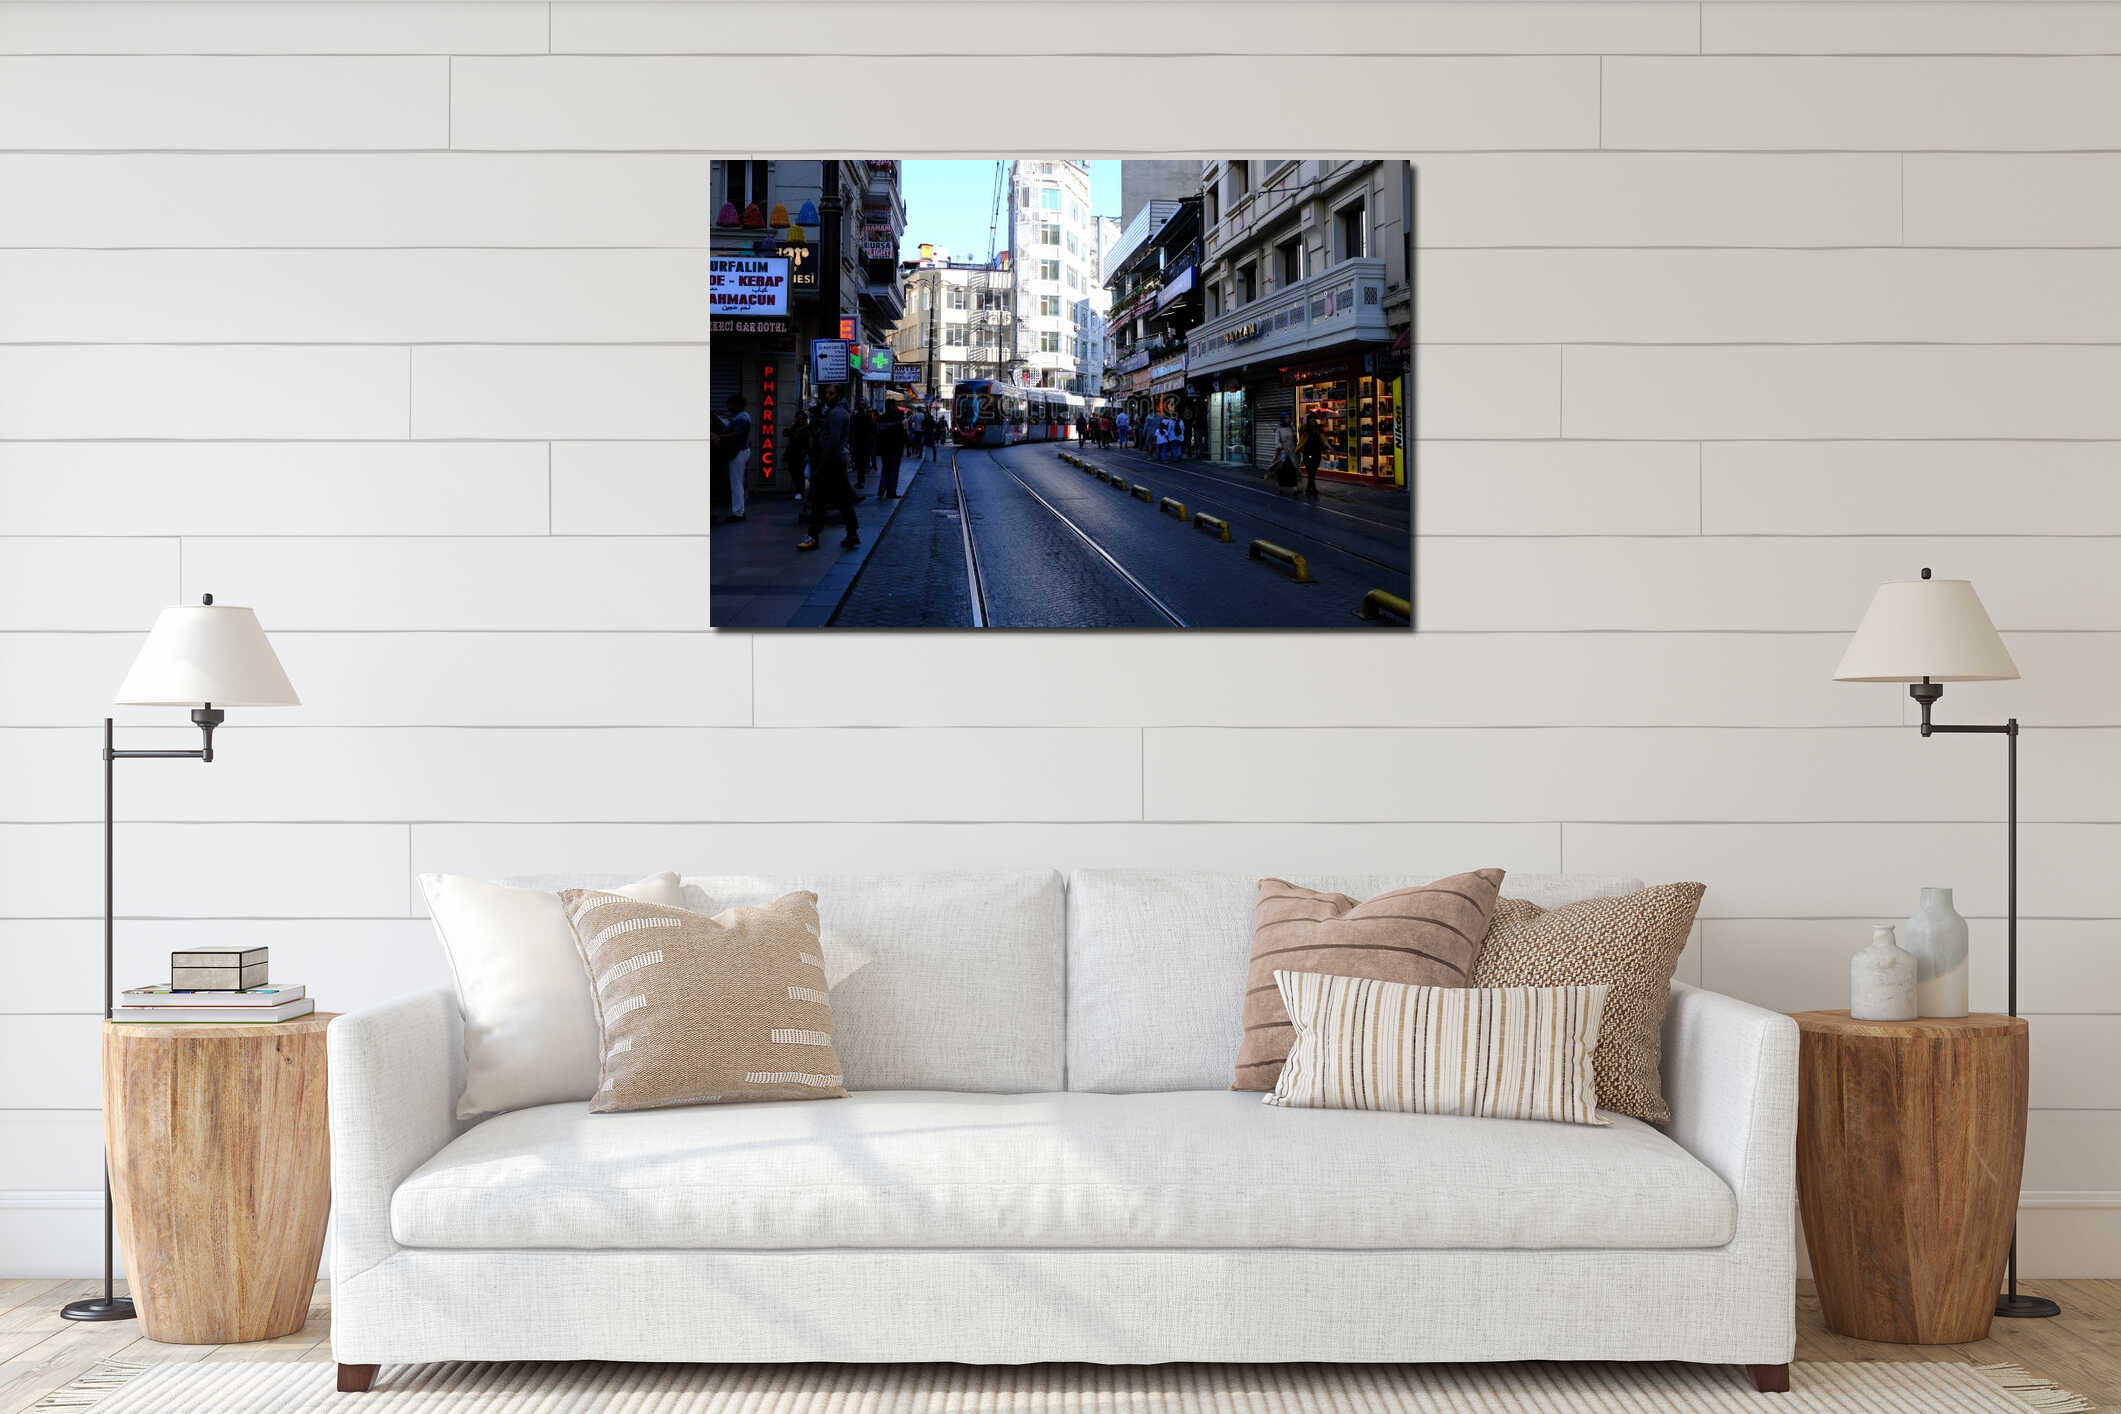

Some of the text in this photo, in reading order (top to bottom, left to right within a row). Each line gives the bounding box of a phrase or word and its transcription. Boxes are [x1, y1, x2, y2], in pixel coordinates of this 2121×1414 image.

[738, 275, 784, 287] KEBAP
[762, 365, 774, 479] PHARMACY
[1394, 405, 1403, 449] Nikon
